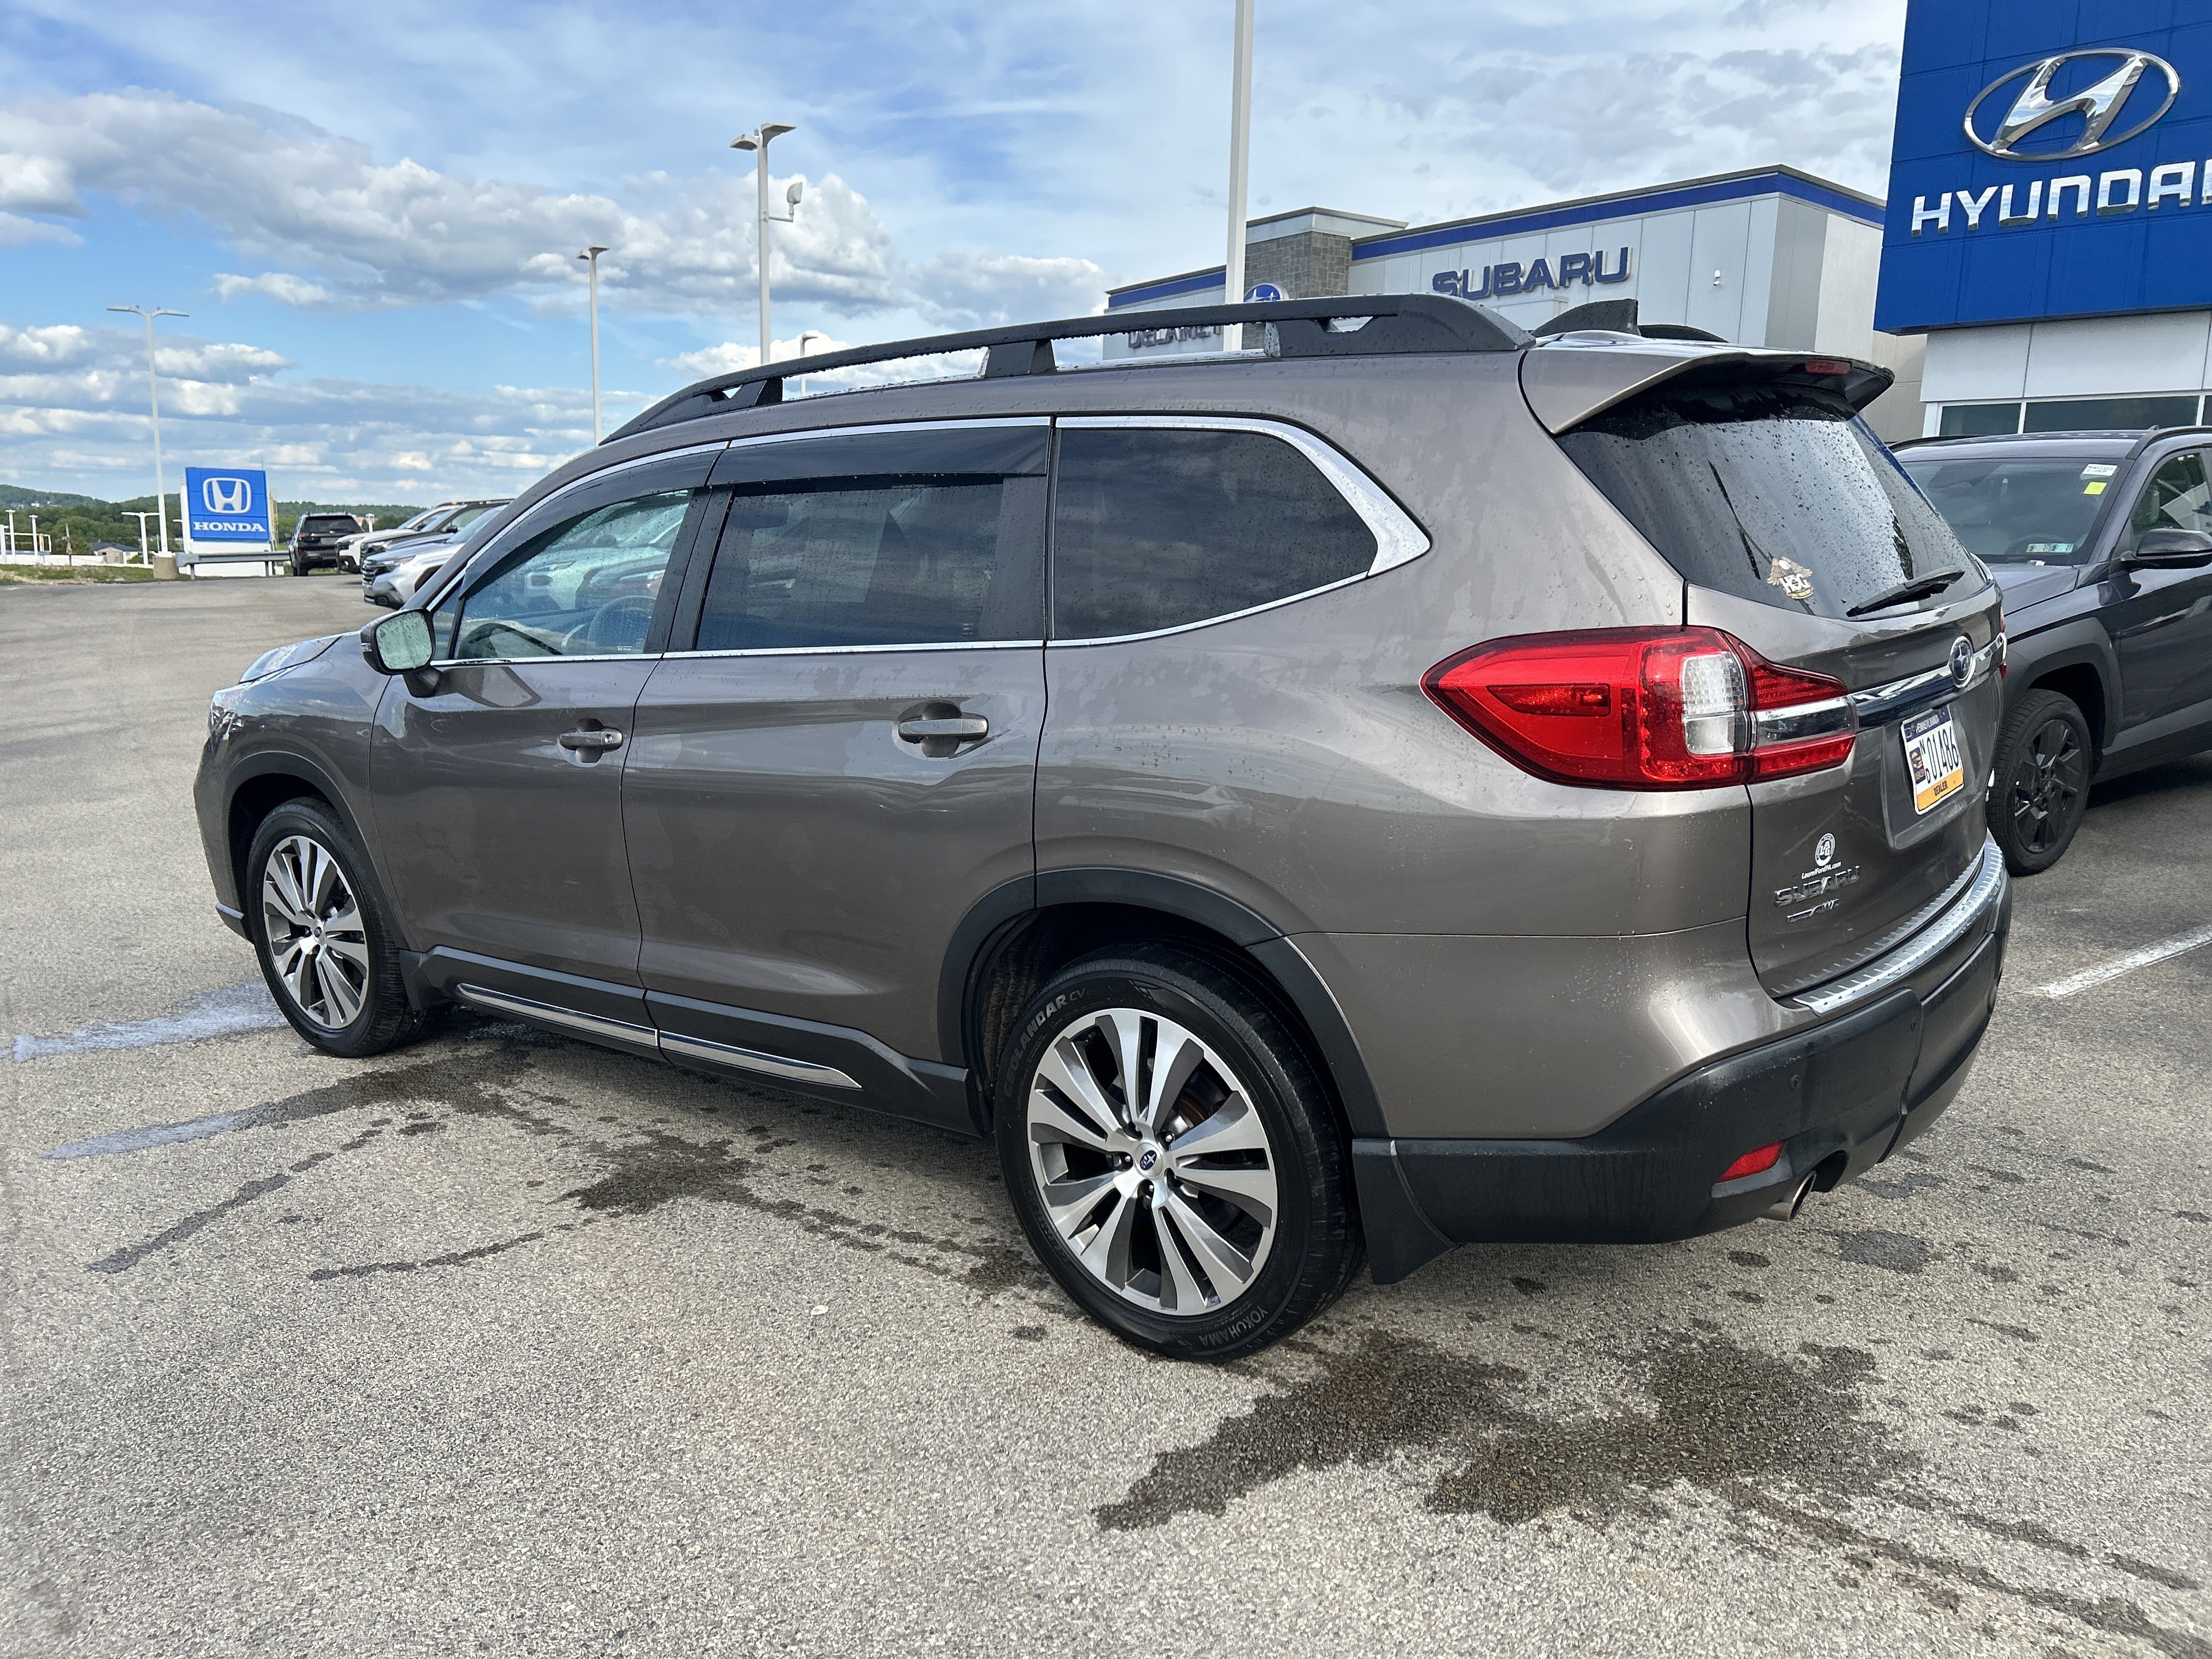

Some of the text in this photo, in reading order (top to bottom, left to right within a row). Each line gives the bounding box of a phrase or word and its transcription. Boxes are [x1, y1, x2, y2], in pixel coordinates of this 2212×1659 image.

[1432, 246, 1632, 301] SUBARU
[193, 522, 266, 532] HONDA
[1003, 994, 1068, 1097] GEOLANDAR
[1070, 988, 1086, 1001] CV
[1199, 1305, 1268, 1347] YOKOHAMA
